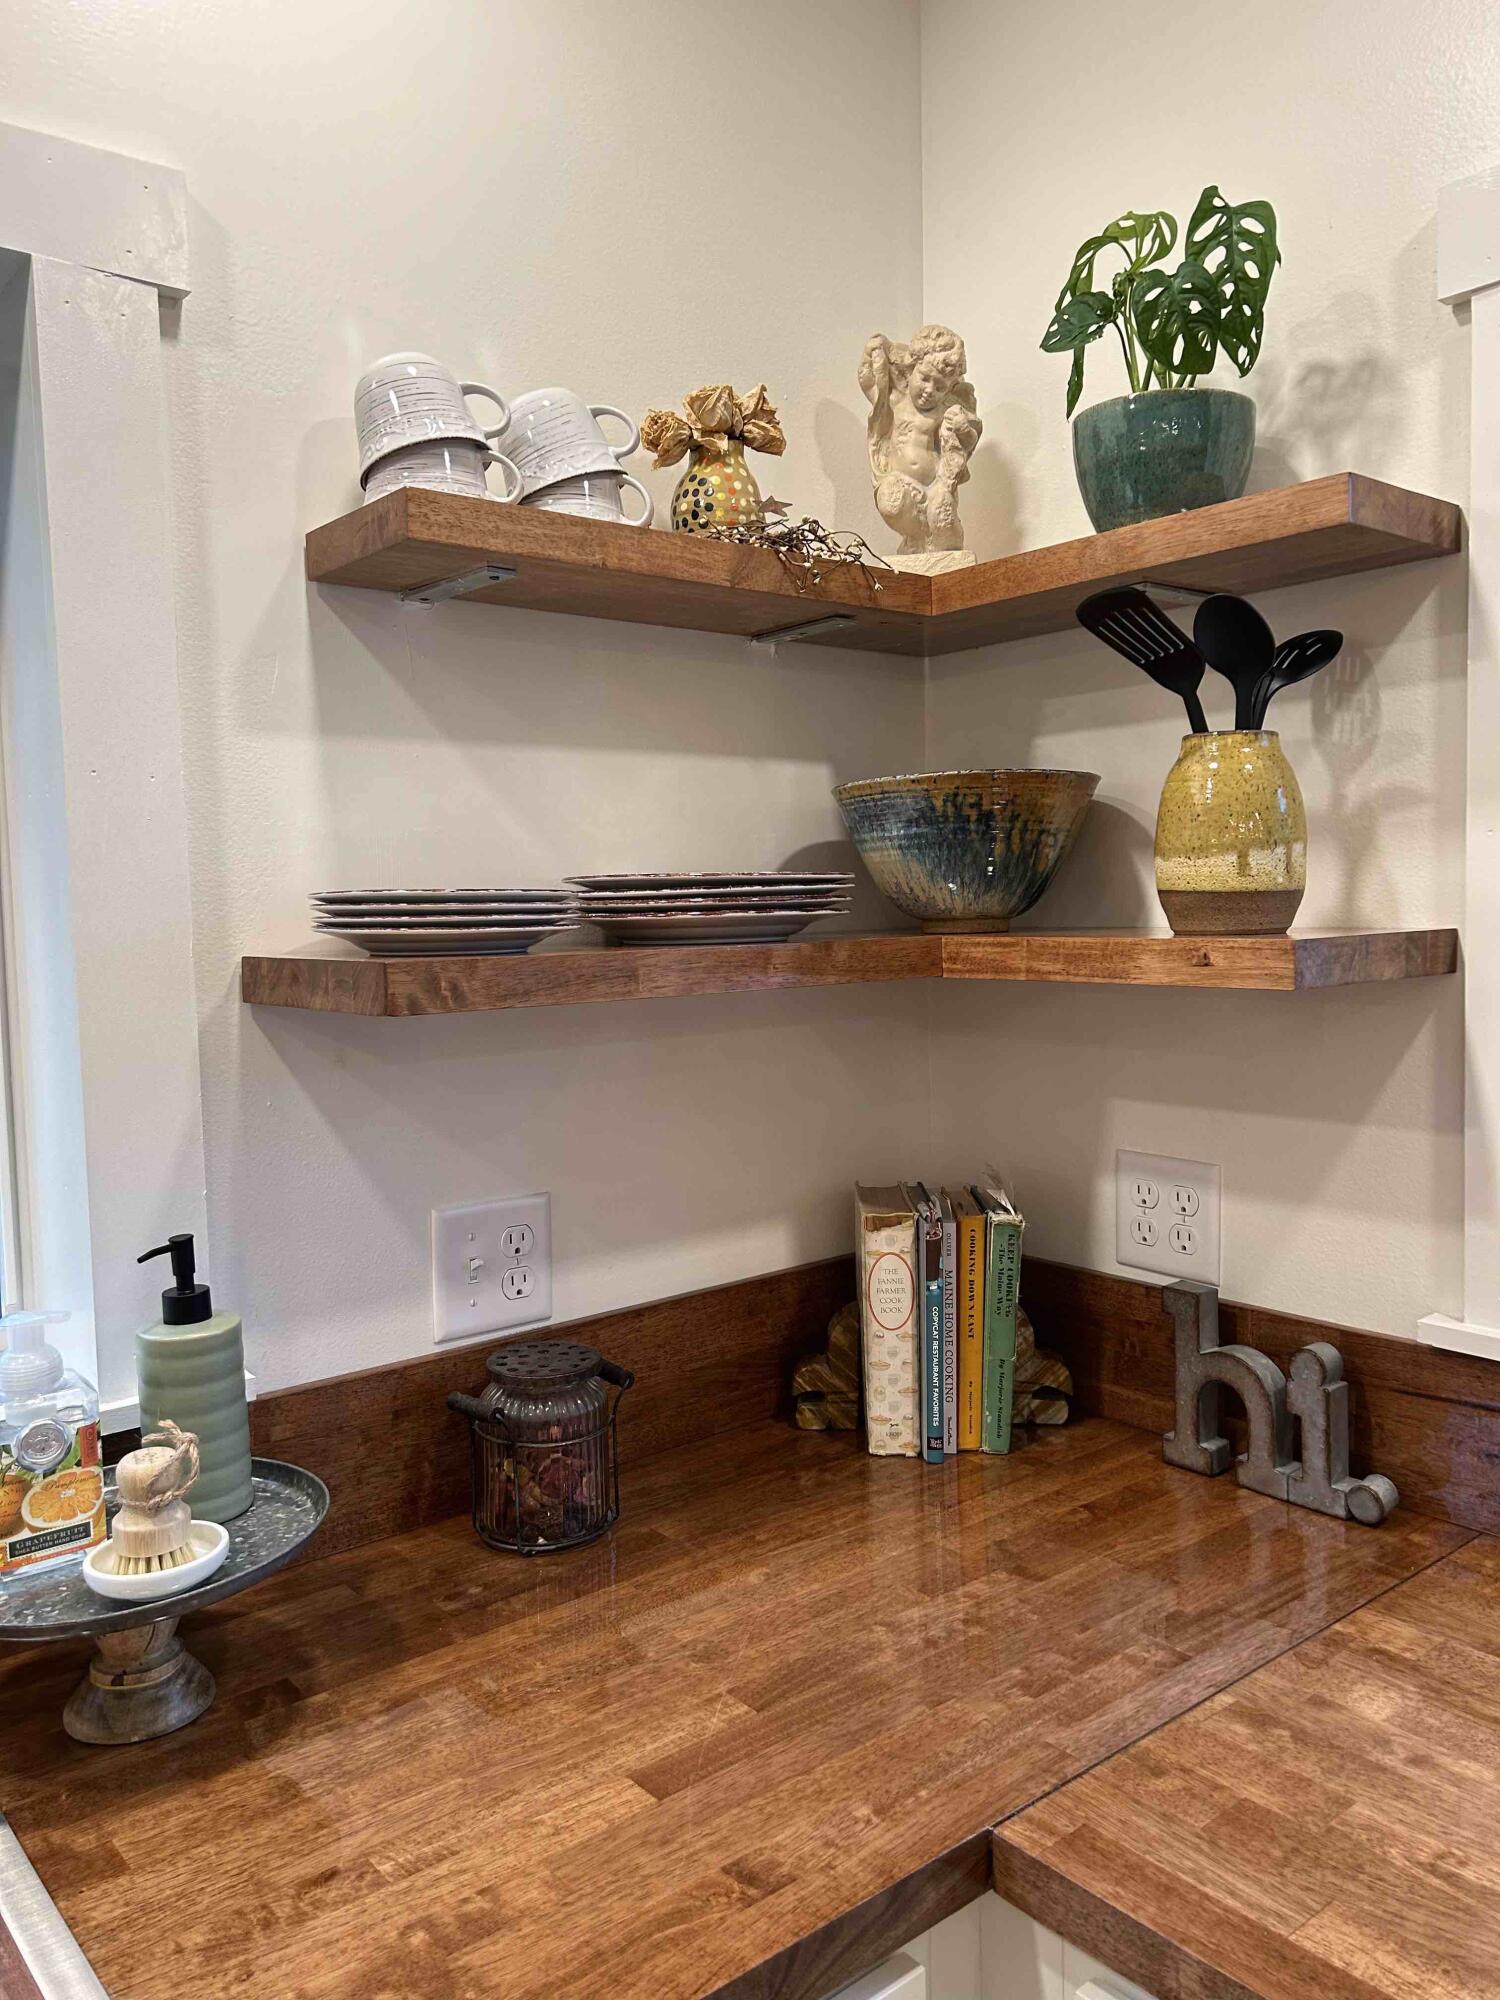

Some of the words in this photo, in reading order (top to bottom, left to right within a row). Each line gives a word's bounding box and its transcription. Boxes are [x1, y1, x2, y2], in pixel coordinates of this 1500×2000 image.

[968, 1228, 977, 1276] COOKING
[1006, 1233, 1016, 1264] KEEP
[876, 1287, 906, 1295] FARMER
[944, 1269, 954, 1310] MAINE
[968, 1279, 976, 1311] DOWN
[996, 1267, 1005, 1295] Maine
[880, 1297, 903, 1305] COOK
[880, 1306, 903, 1314] BOOK
[994, 1296, 1004, 1317] Way
[944, 1311, 954, 1347] HOME
[967, 1314, 976, 1340] EAST
[944, 1349, 954, 1404] COOKING
[932, 1387, 940, 1427] FAVORITES
[15, 1547, 31, 1556] SHEA
[31, 1541, 54, 1551] BUTTER
[54, 1536, 71, 1545] HAND
[71, 1532, 86, 1541] SOAP
[16, 1526, 86, 1550] GRAPEFRUIT
